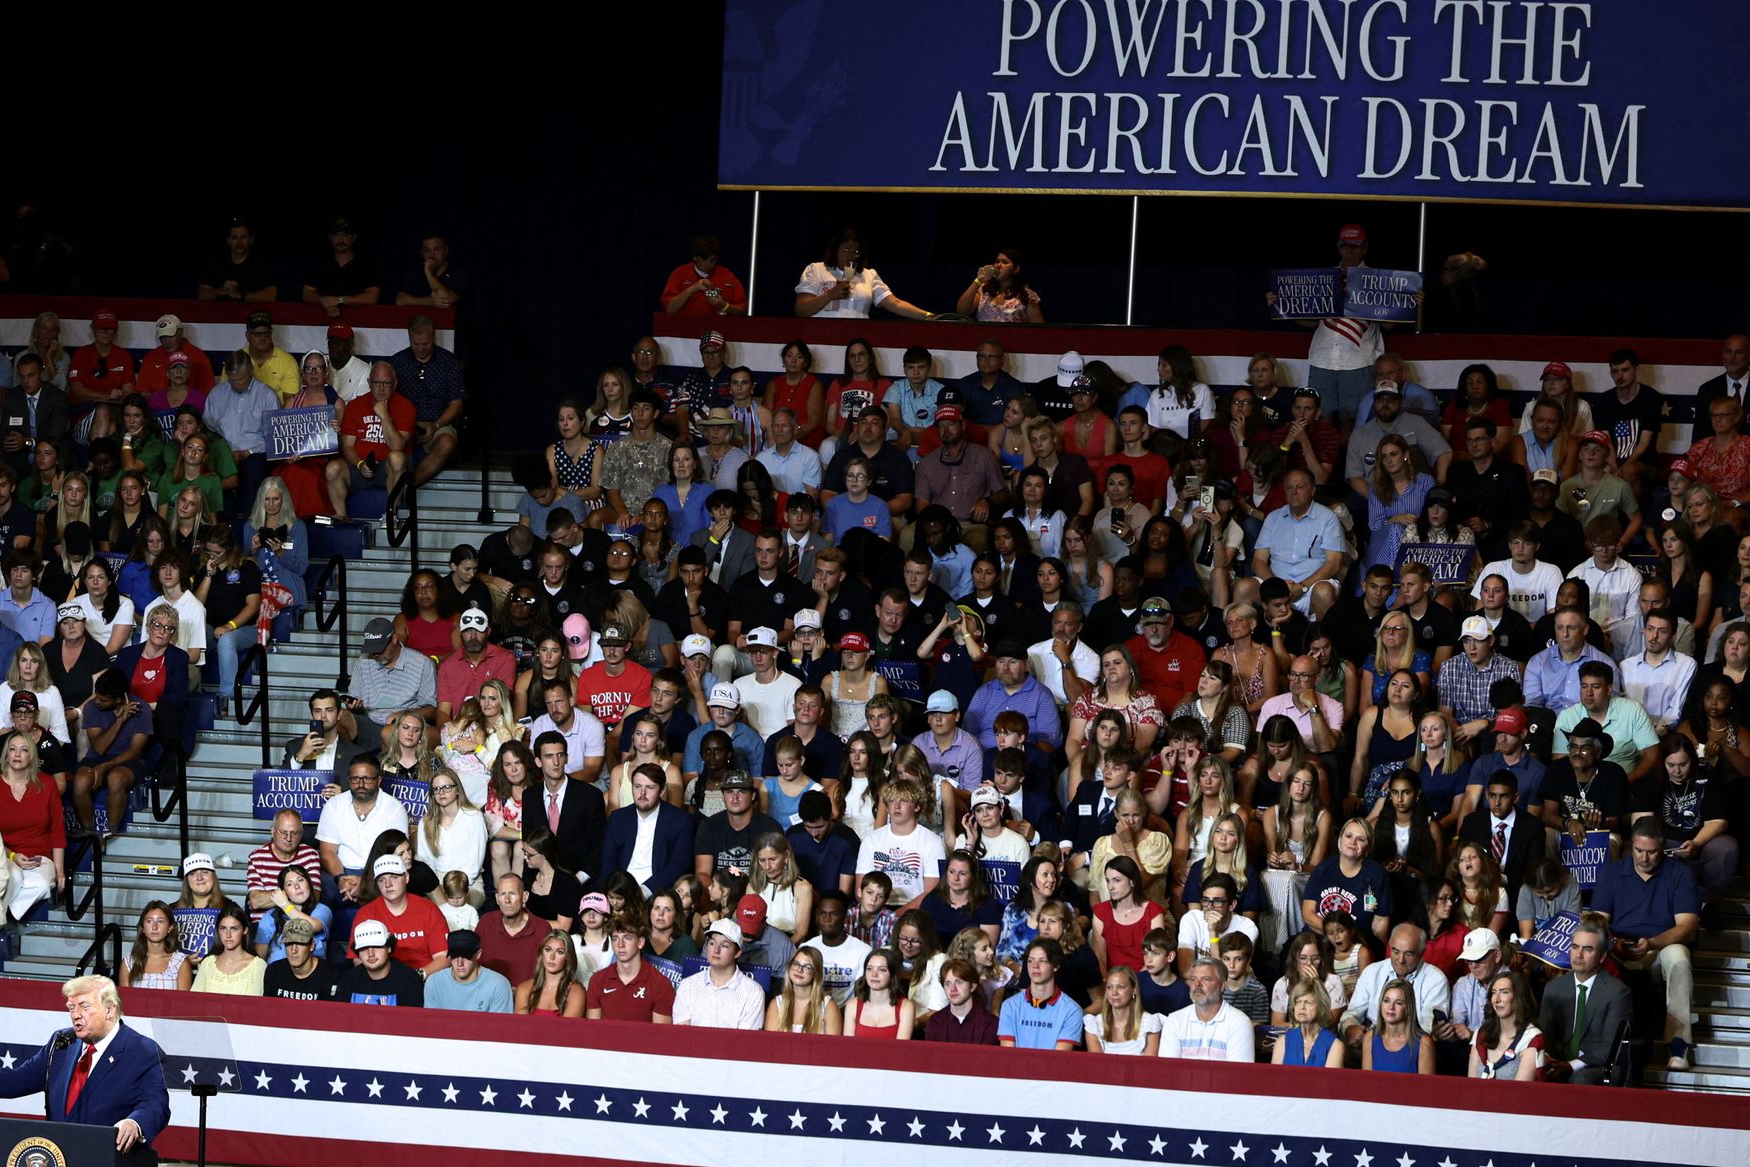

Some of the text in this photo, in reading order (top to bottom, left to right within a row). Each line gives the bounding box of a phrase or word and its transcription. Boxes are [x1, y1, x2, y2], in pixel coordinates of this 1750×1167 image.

[993, 0, 1593, 87] POWERING THE
[928, 90, 1646, 189] AMERICAN DREAM
[1277, 275, 1335, 284] POWERING THE
[1362, 275, 1408, 291] TRUMP
[1278, 285, 1334, 297] AMERICAN
[1279, 297, 1336, 314] DREAM
[1349, 291, 1417, 309] ACCOUNTS
[1044, 402, 1074, 410] FREED
[271, 411, 329, 425] POWERING THE
[272, 420, 330, 438] AMERICAN
[274, 433, 331, 455] DREAM
[1402, 554, 1467, 564] AMERICAN
[1406, 548, 1449, 556] POWERING
[1512, 593, 1545, 601] EEDOM
[874, 666, 904, 680] UMP
[591, 691, 622, 706] BORN
[713, 690, 733, 699] USA
[268, 776, 319, 791] TRUMP
[390, 783, 430, 804] TRUM
[1561, 848, 1607, 866] ACCOUNTS
[1570, 866, 1596, 883] TRUM
[177, 923, 216, 937] MERIC
[1551, 916, 1579, 935] TRU
[178, 932, 209, 955] REA
[1530, 929, 1572, 953] ACCOU
[1021, 1020, 1052, 1029] FREEDOM
[9, 1139, 36, 1167] PRESIDENT
